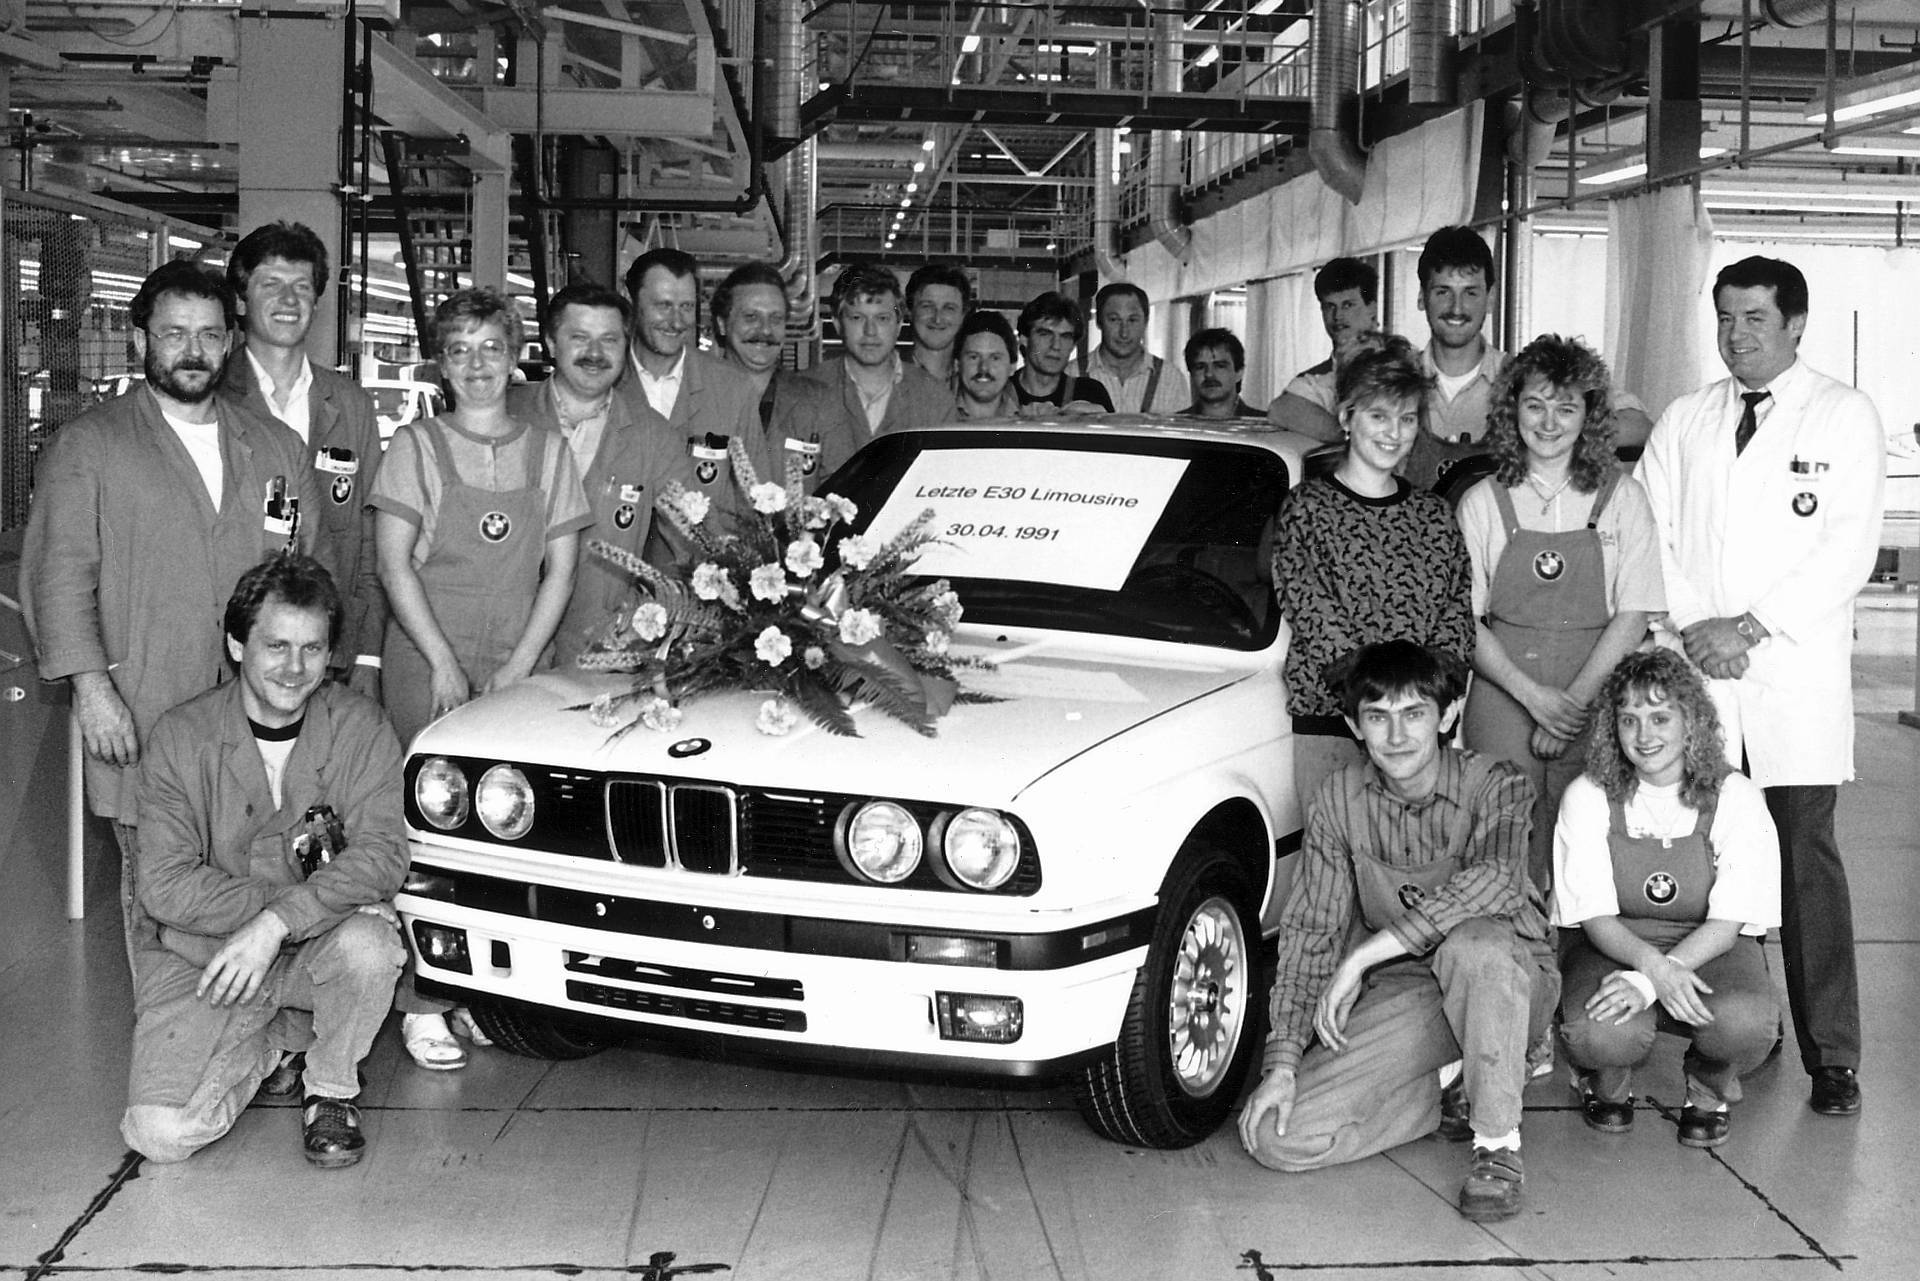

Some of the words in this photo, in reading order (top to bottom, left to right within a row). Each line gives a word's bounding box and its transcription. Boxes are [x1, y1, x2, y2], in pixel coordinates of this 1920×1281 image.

[914, 485, 978, 498] Letzte
[982, 486, 1026, 500] E30
[1030, 487, 1139, 508] Limousine
